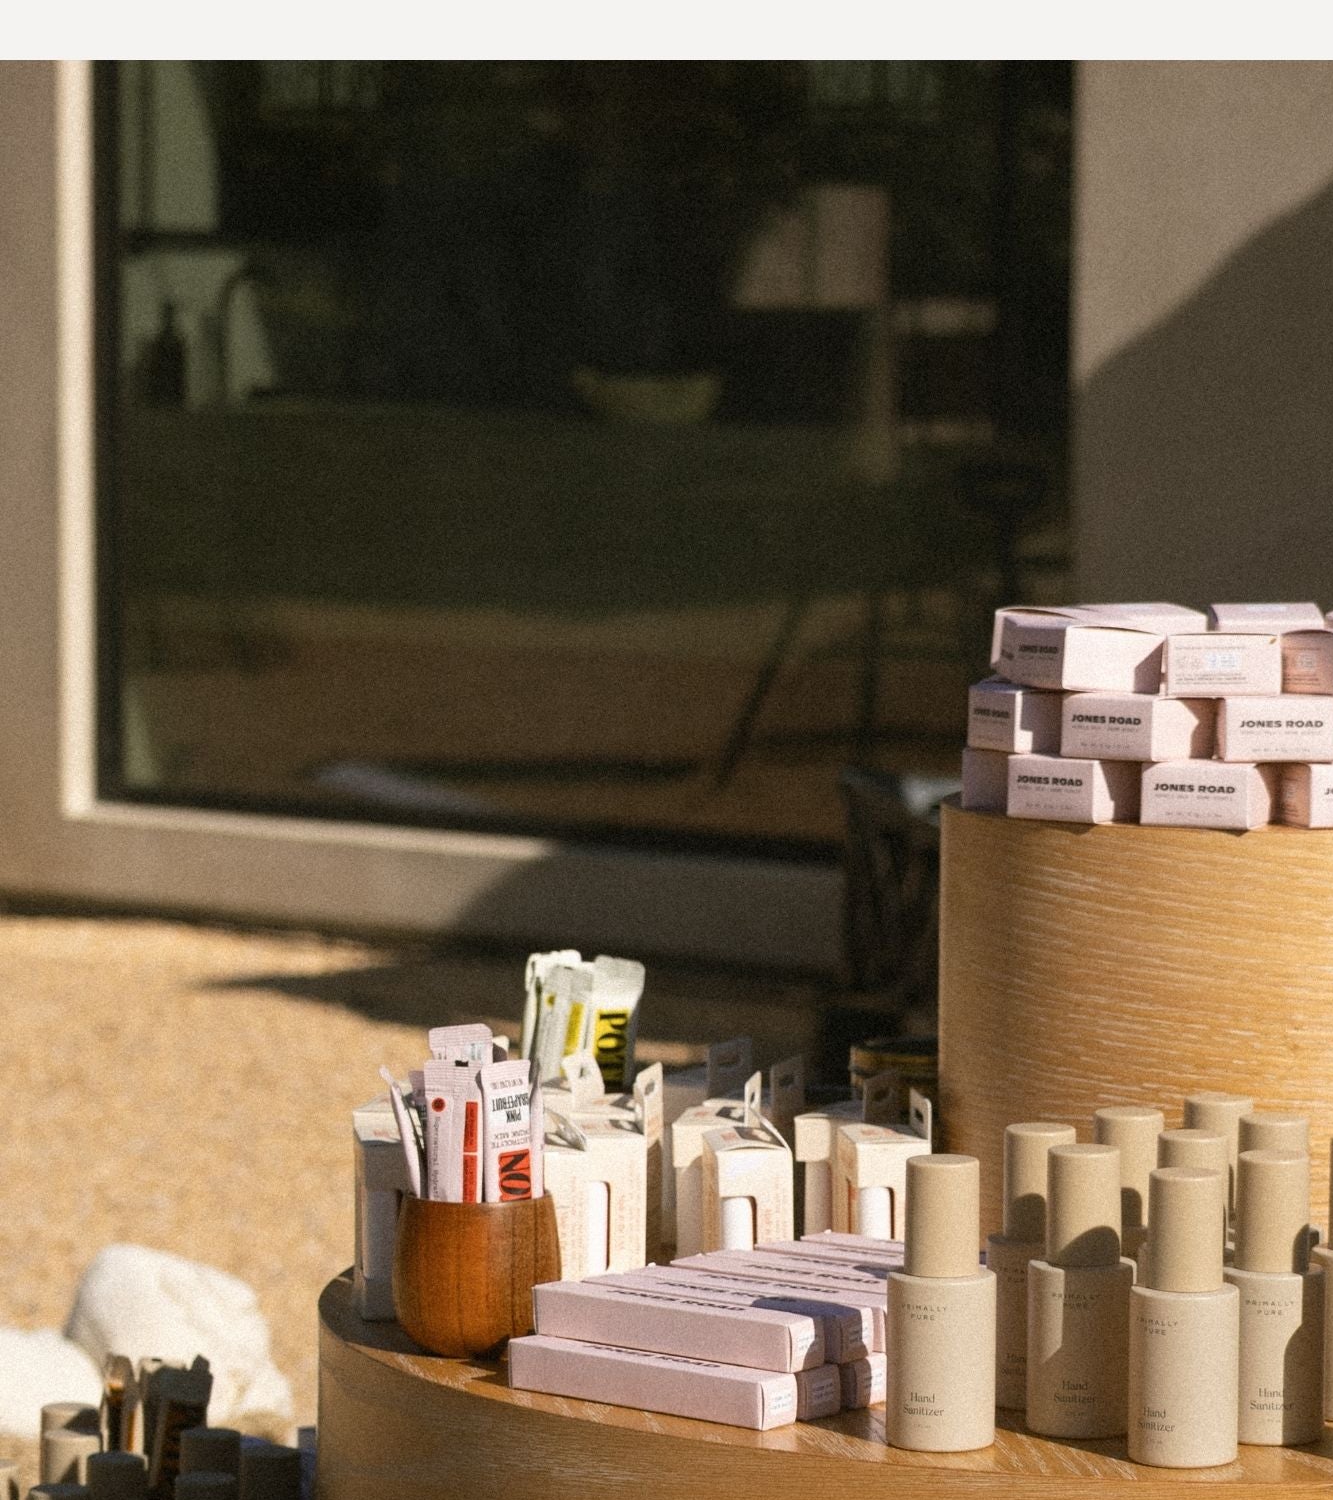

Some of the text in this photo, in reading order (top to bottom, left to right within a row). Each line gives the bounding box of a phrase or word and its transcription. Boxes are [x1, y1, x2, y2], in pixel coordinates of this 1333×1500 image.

[1072, 714, 1141, 726] JONES ROAD
[1240, 720, 1324, 729] JONES ROAD
[1017, 775, 1083, 787] JONES ROAD
[1154, 783, 1236, 794] JONES ROAD
[910, 1392, 935, 1403] Hand
[903, 1406, 944, 1417] Sanitizer
[1143, 1406, 1166, 1418] Hand
